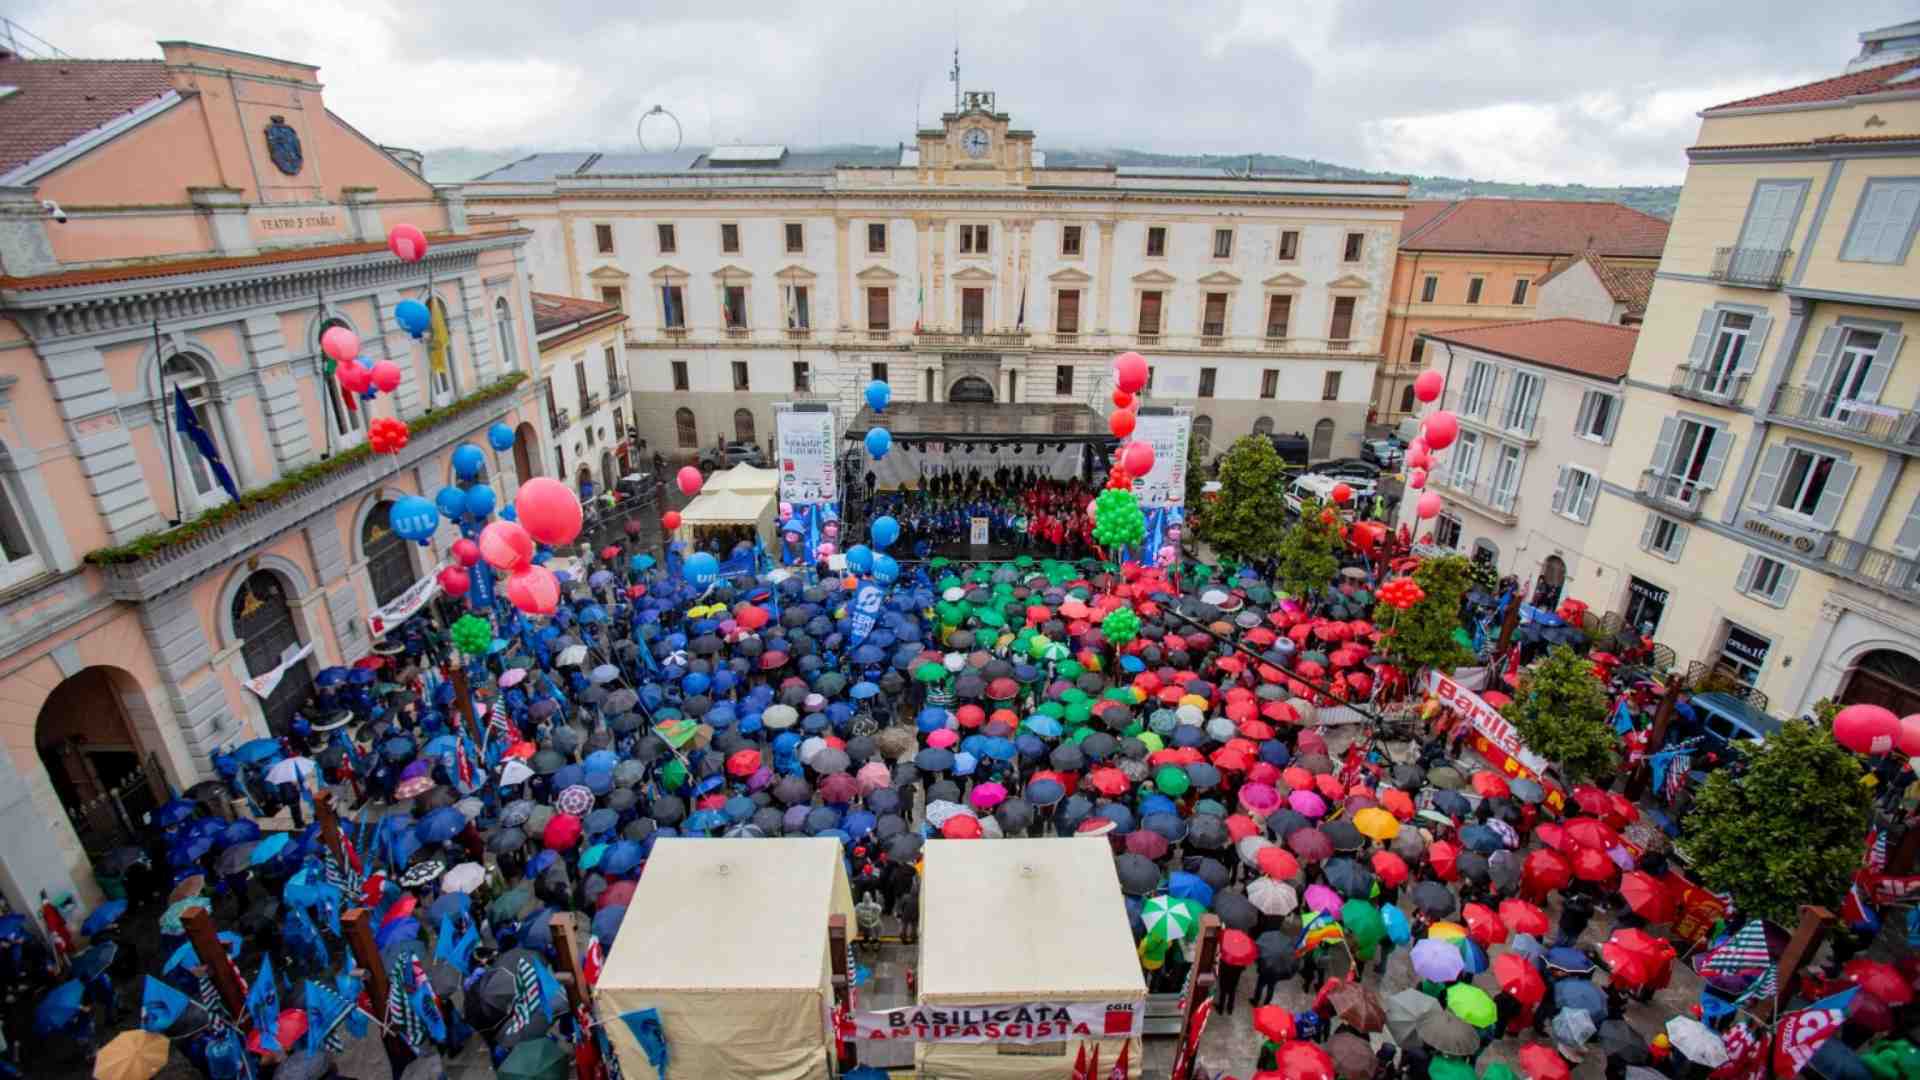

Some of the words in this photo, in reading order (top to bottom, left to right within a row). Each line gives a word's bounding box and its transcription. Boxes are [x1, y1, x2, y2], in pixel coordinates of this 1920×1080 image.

[261, 218, 295, 230] TEATRO
[395, 513, 434, 533] UIL
[696, 573, 717, 583] UIL
[1727, 638, 1752, 655] OPERA
[1437, 678, 1521, 753] Barilla
[1105, 1003, 1134, 1012] CGIL
[888, 1007, 1072, 1027] BASILICATA
[869, 1020, 1091, 1040] ANTIFASCISTA
